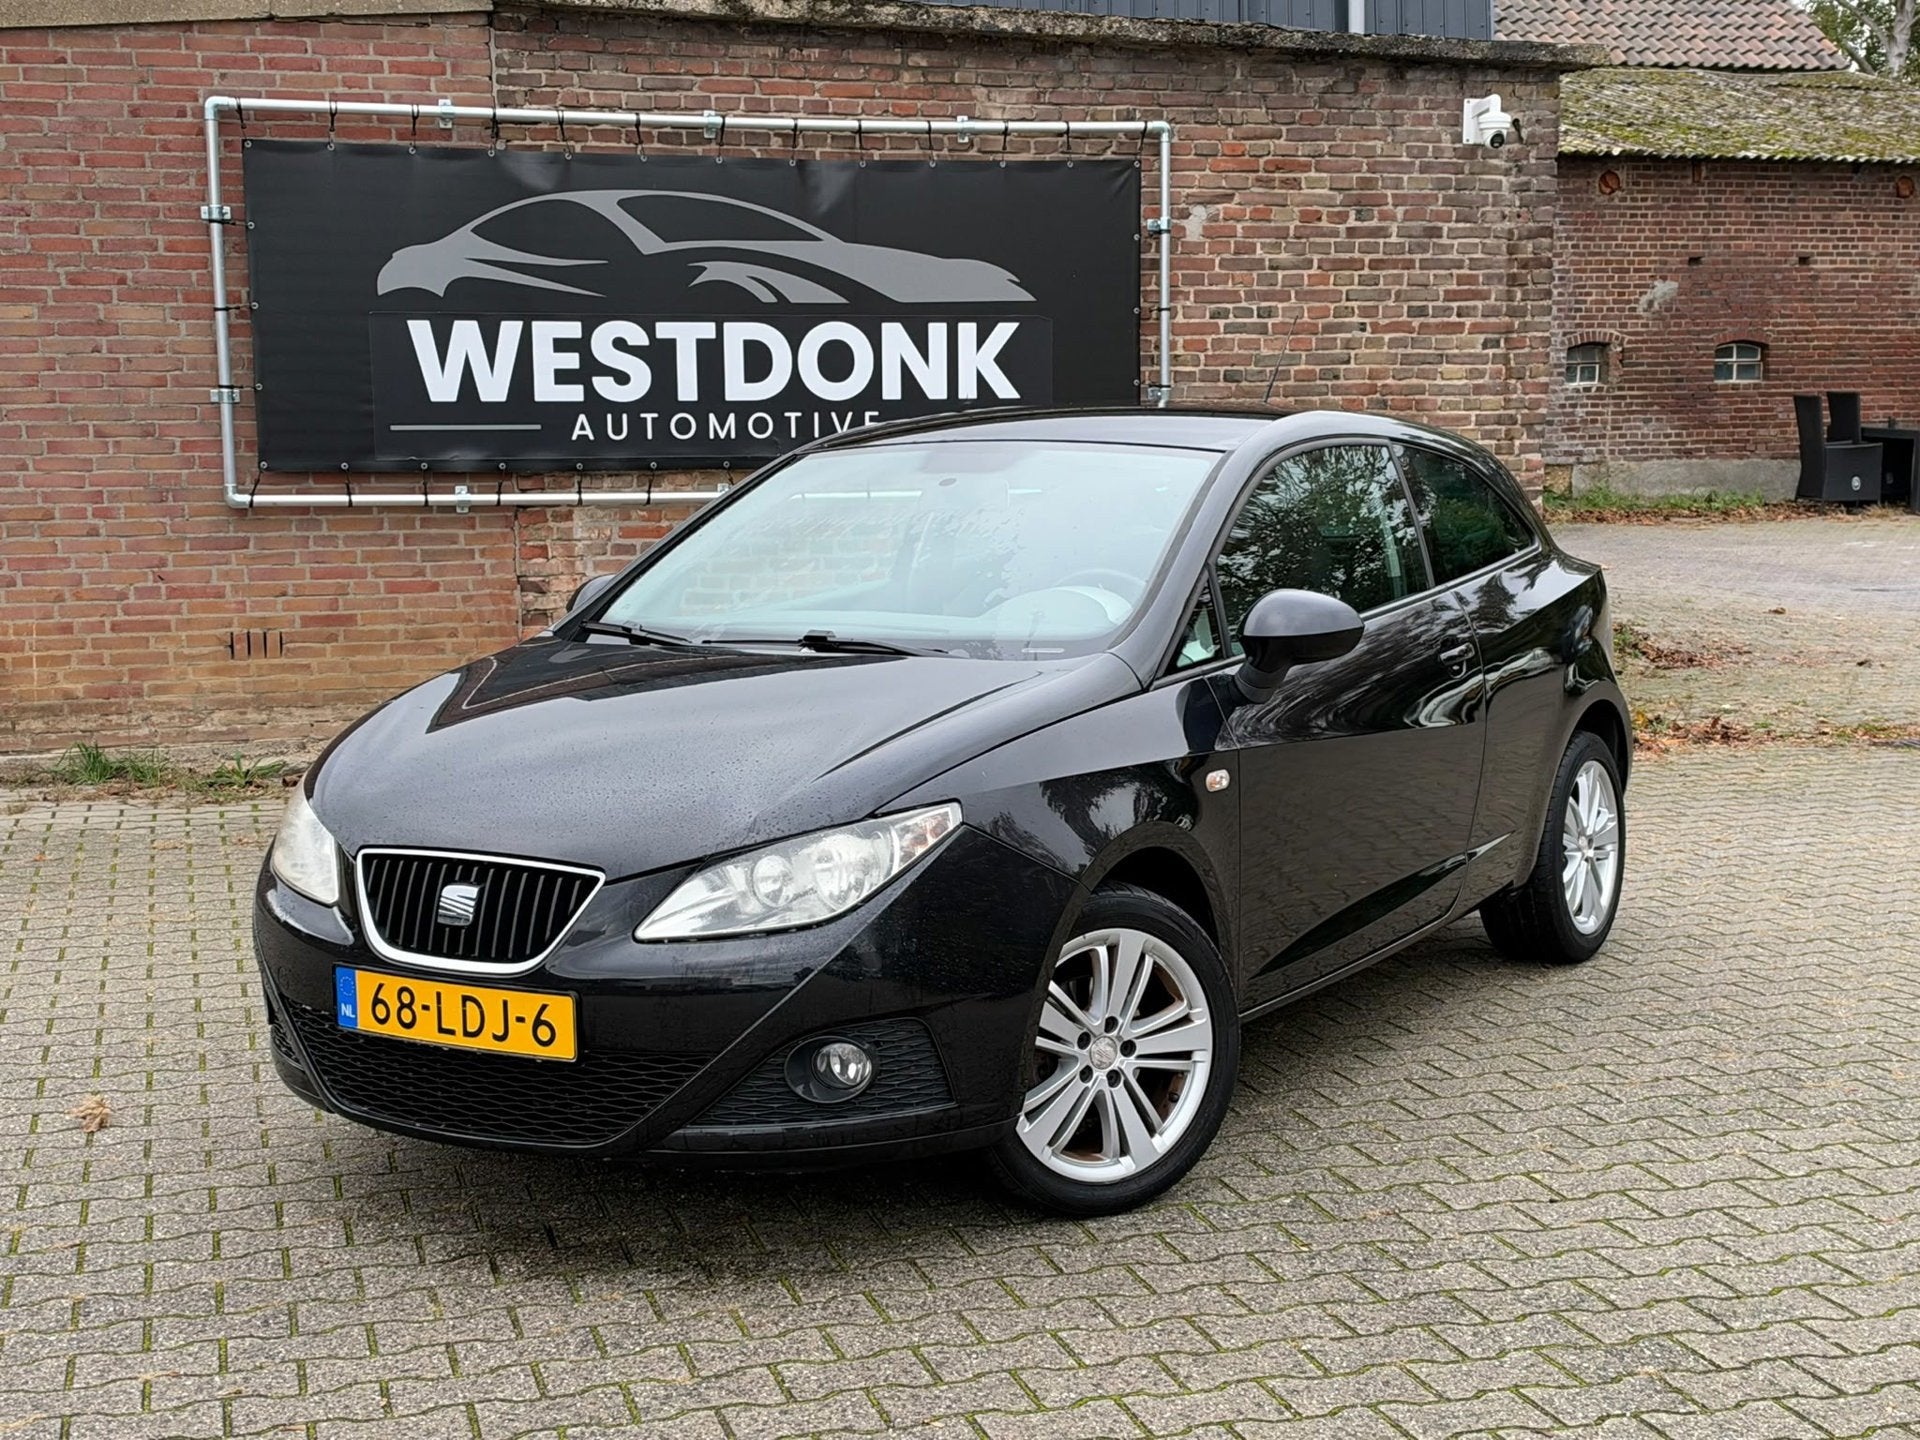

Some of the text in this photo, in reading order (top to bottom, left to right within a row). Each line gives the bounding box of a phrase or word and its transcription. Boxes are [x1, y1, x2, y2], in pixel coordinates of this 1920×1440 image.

[407, 320, 1021, 402] WESTDONK
[340, 1003, 355, 1018] NL
[371, 982, 557, 1048] 68-LDJ-6
